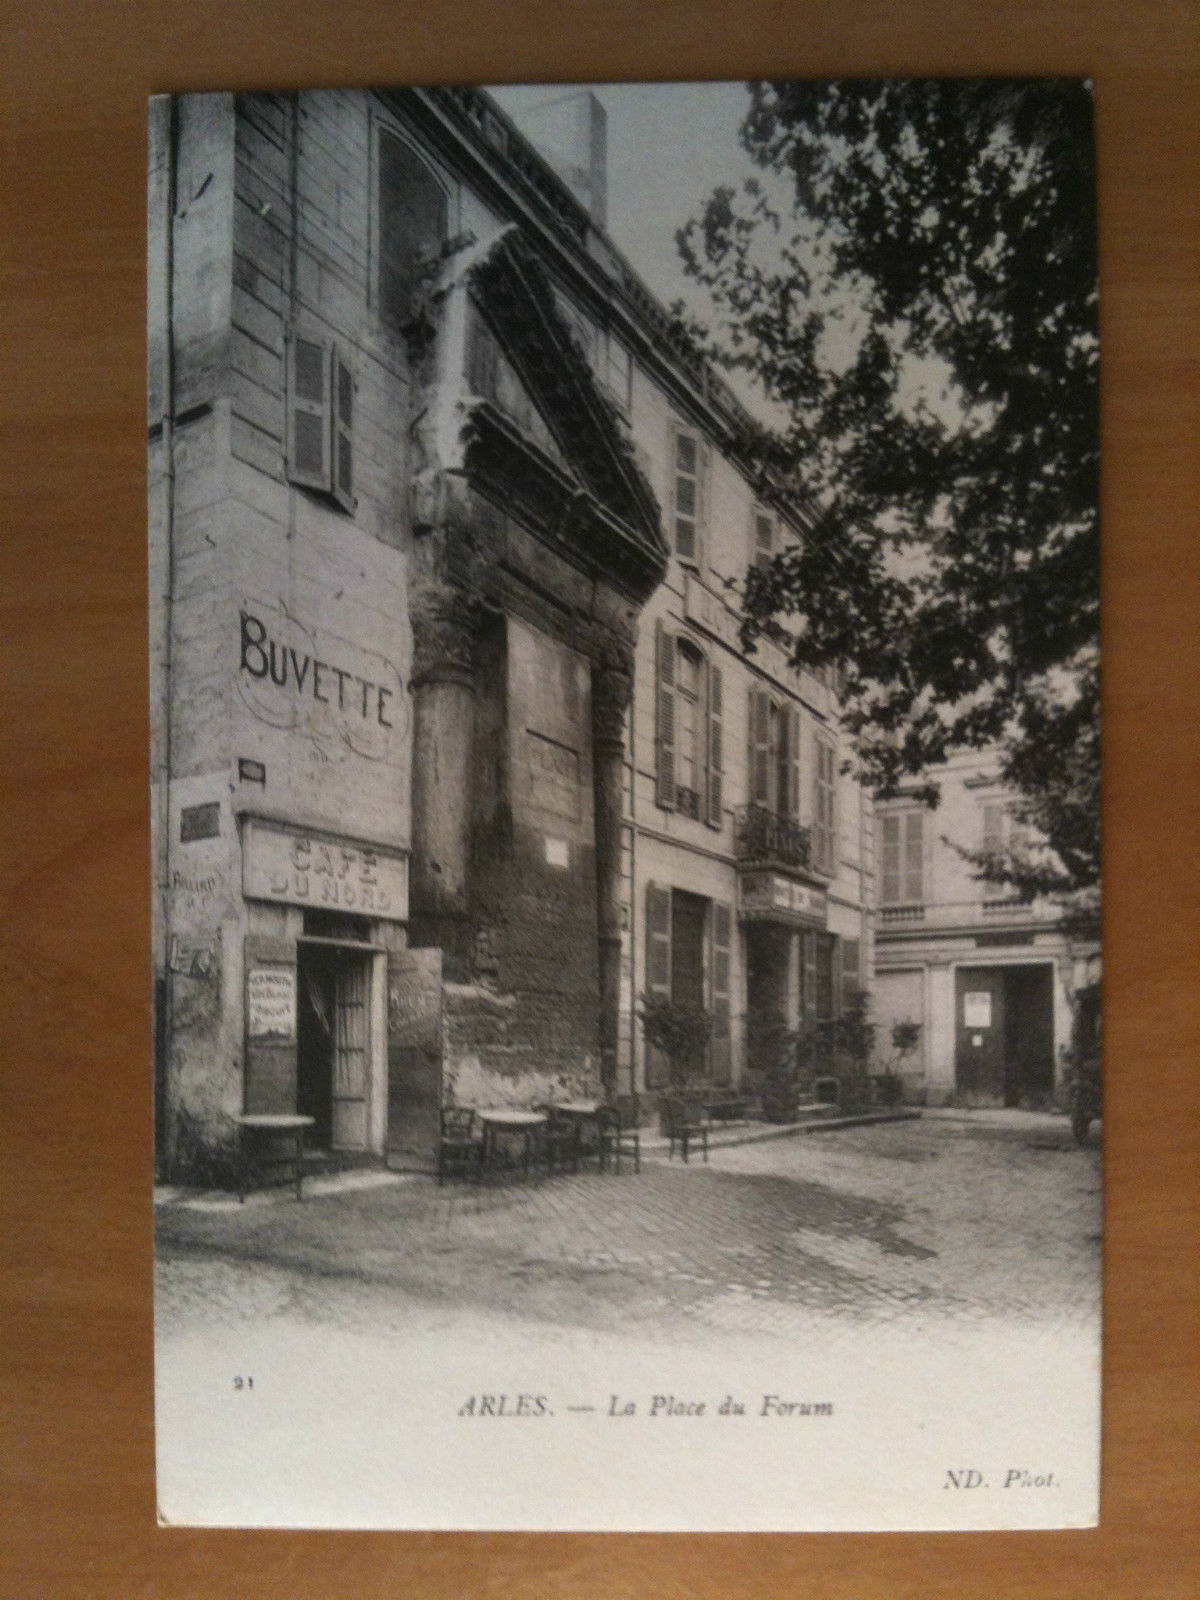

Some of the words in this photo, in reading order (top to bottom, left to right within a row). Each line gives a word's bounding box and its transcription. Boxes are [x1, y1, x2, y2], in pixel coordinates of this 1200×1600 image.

[240, 610, 393, 728] BUVETTE
[321, 879, 391, 911] NORD
[233, 1375, 254, 1390] 21
[457, 1395, 555, 1417] ARLES.
[608, 1395, 637, 1417] La
[649, 1395, 706, 1417] Place
[717, 1395, 746, 1417] du
[759, 1395, 834, 1417] Forum
[942, 1469, 990, 1489] ND.
